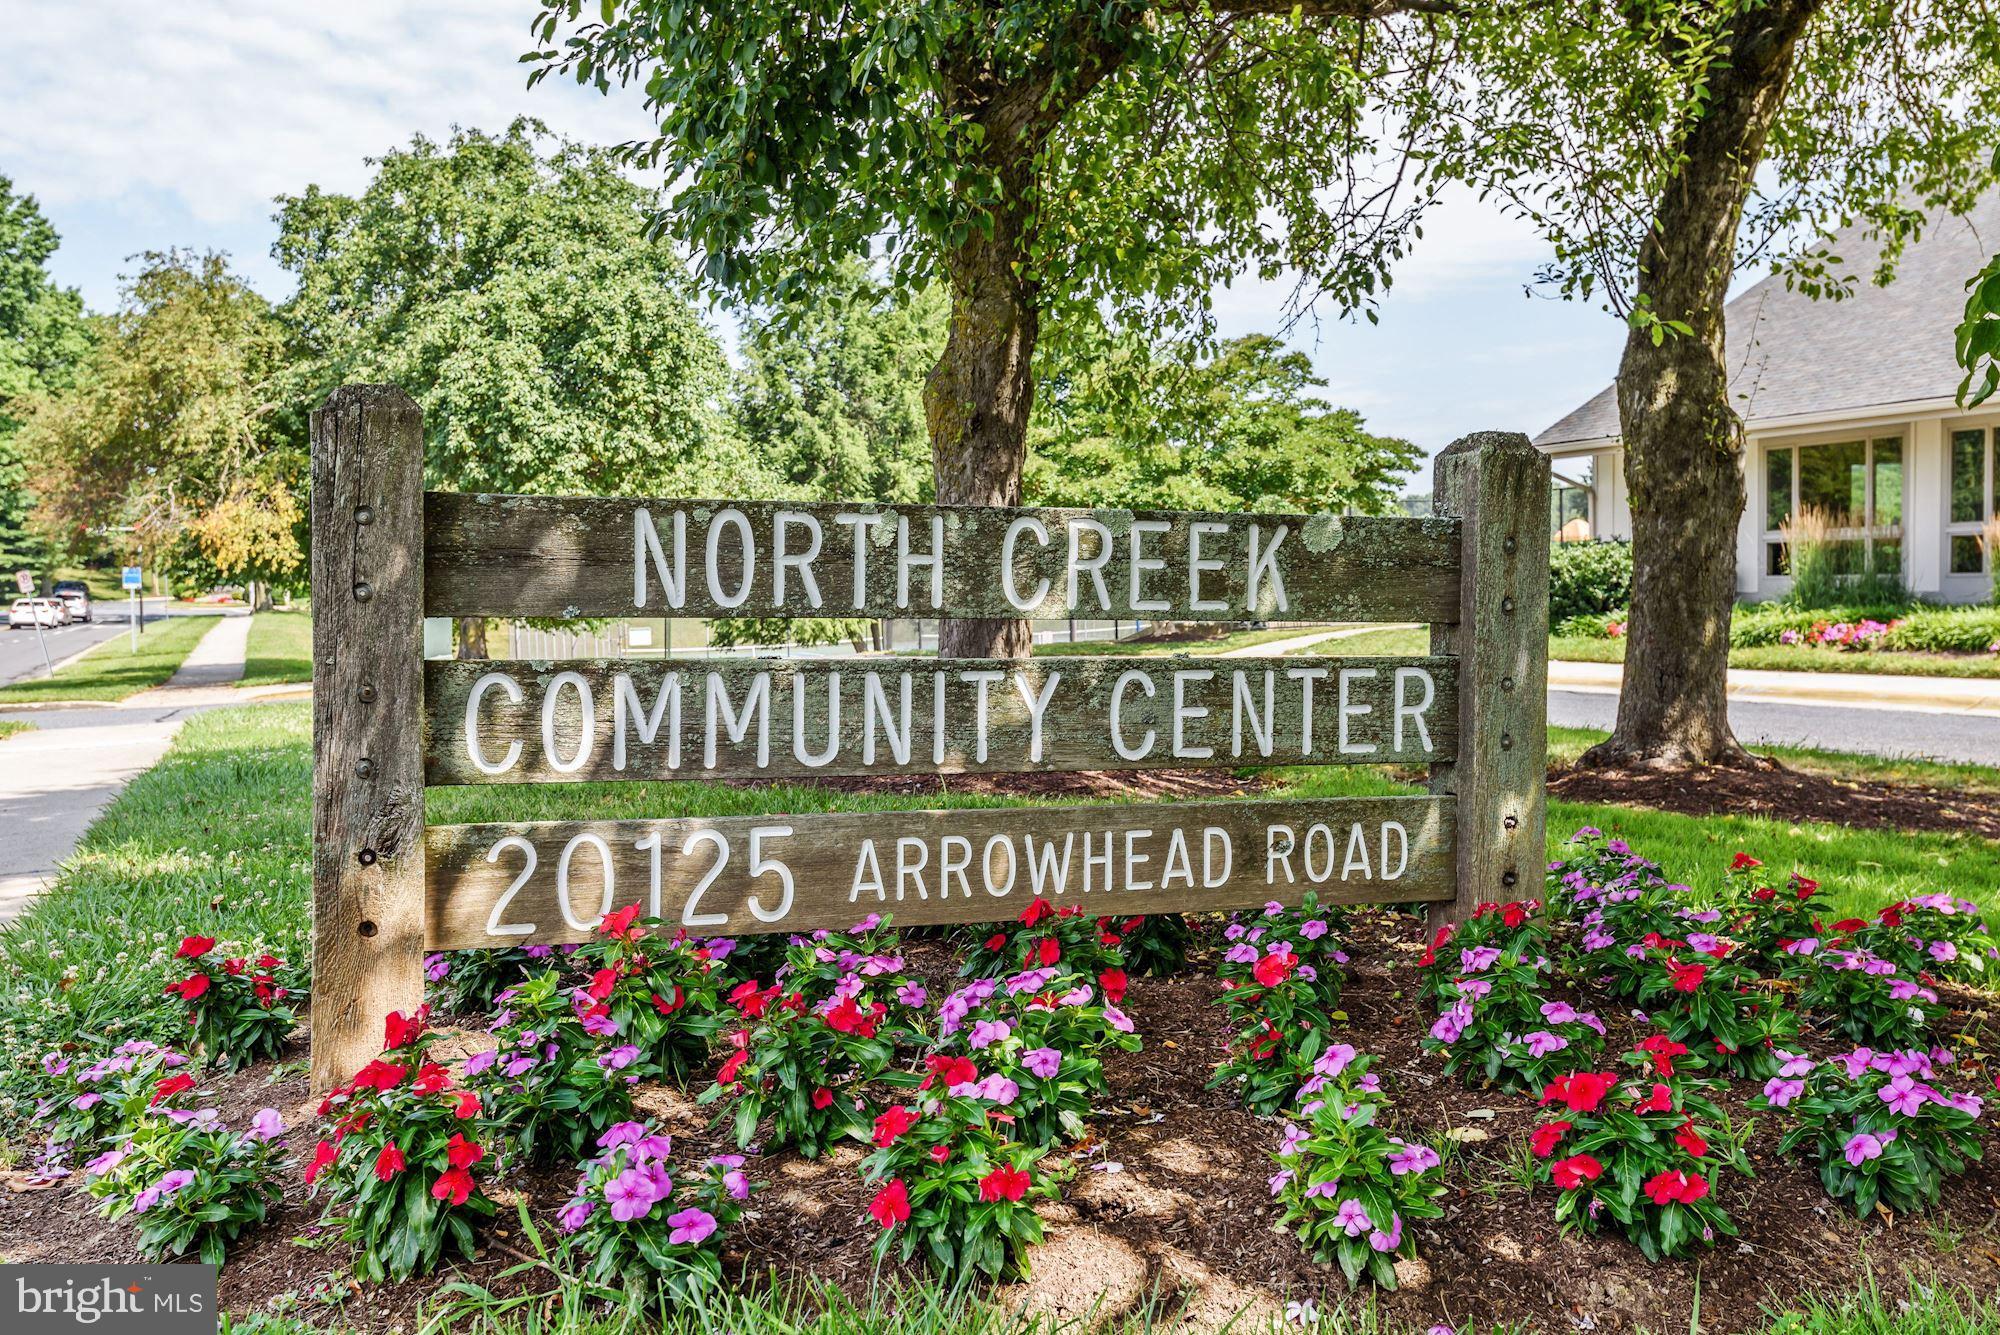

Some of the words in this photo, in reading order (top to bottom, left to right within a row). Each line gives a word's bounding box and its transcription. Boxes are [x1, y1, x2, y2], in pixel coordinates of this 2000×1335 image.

[633, 508, 943, 609] NORTH
[1001, 516, 1289, 613] CREEK
[465, 671, 1060, 775] COMMUNITY
[1110, 666, 1435, 761] CENTER
[486, 826, 794, 936] 20125
[849, 827, 1233, 902] ARROWHEAD
[1266, 821, 1408, 884] ROAD
